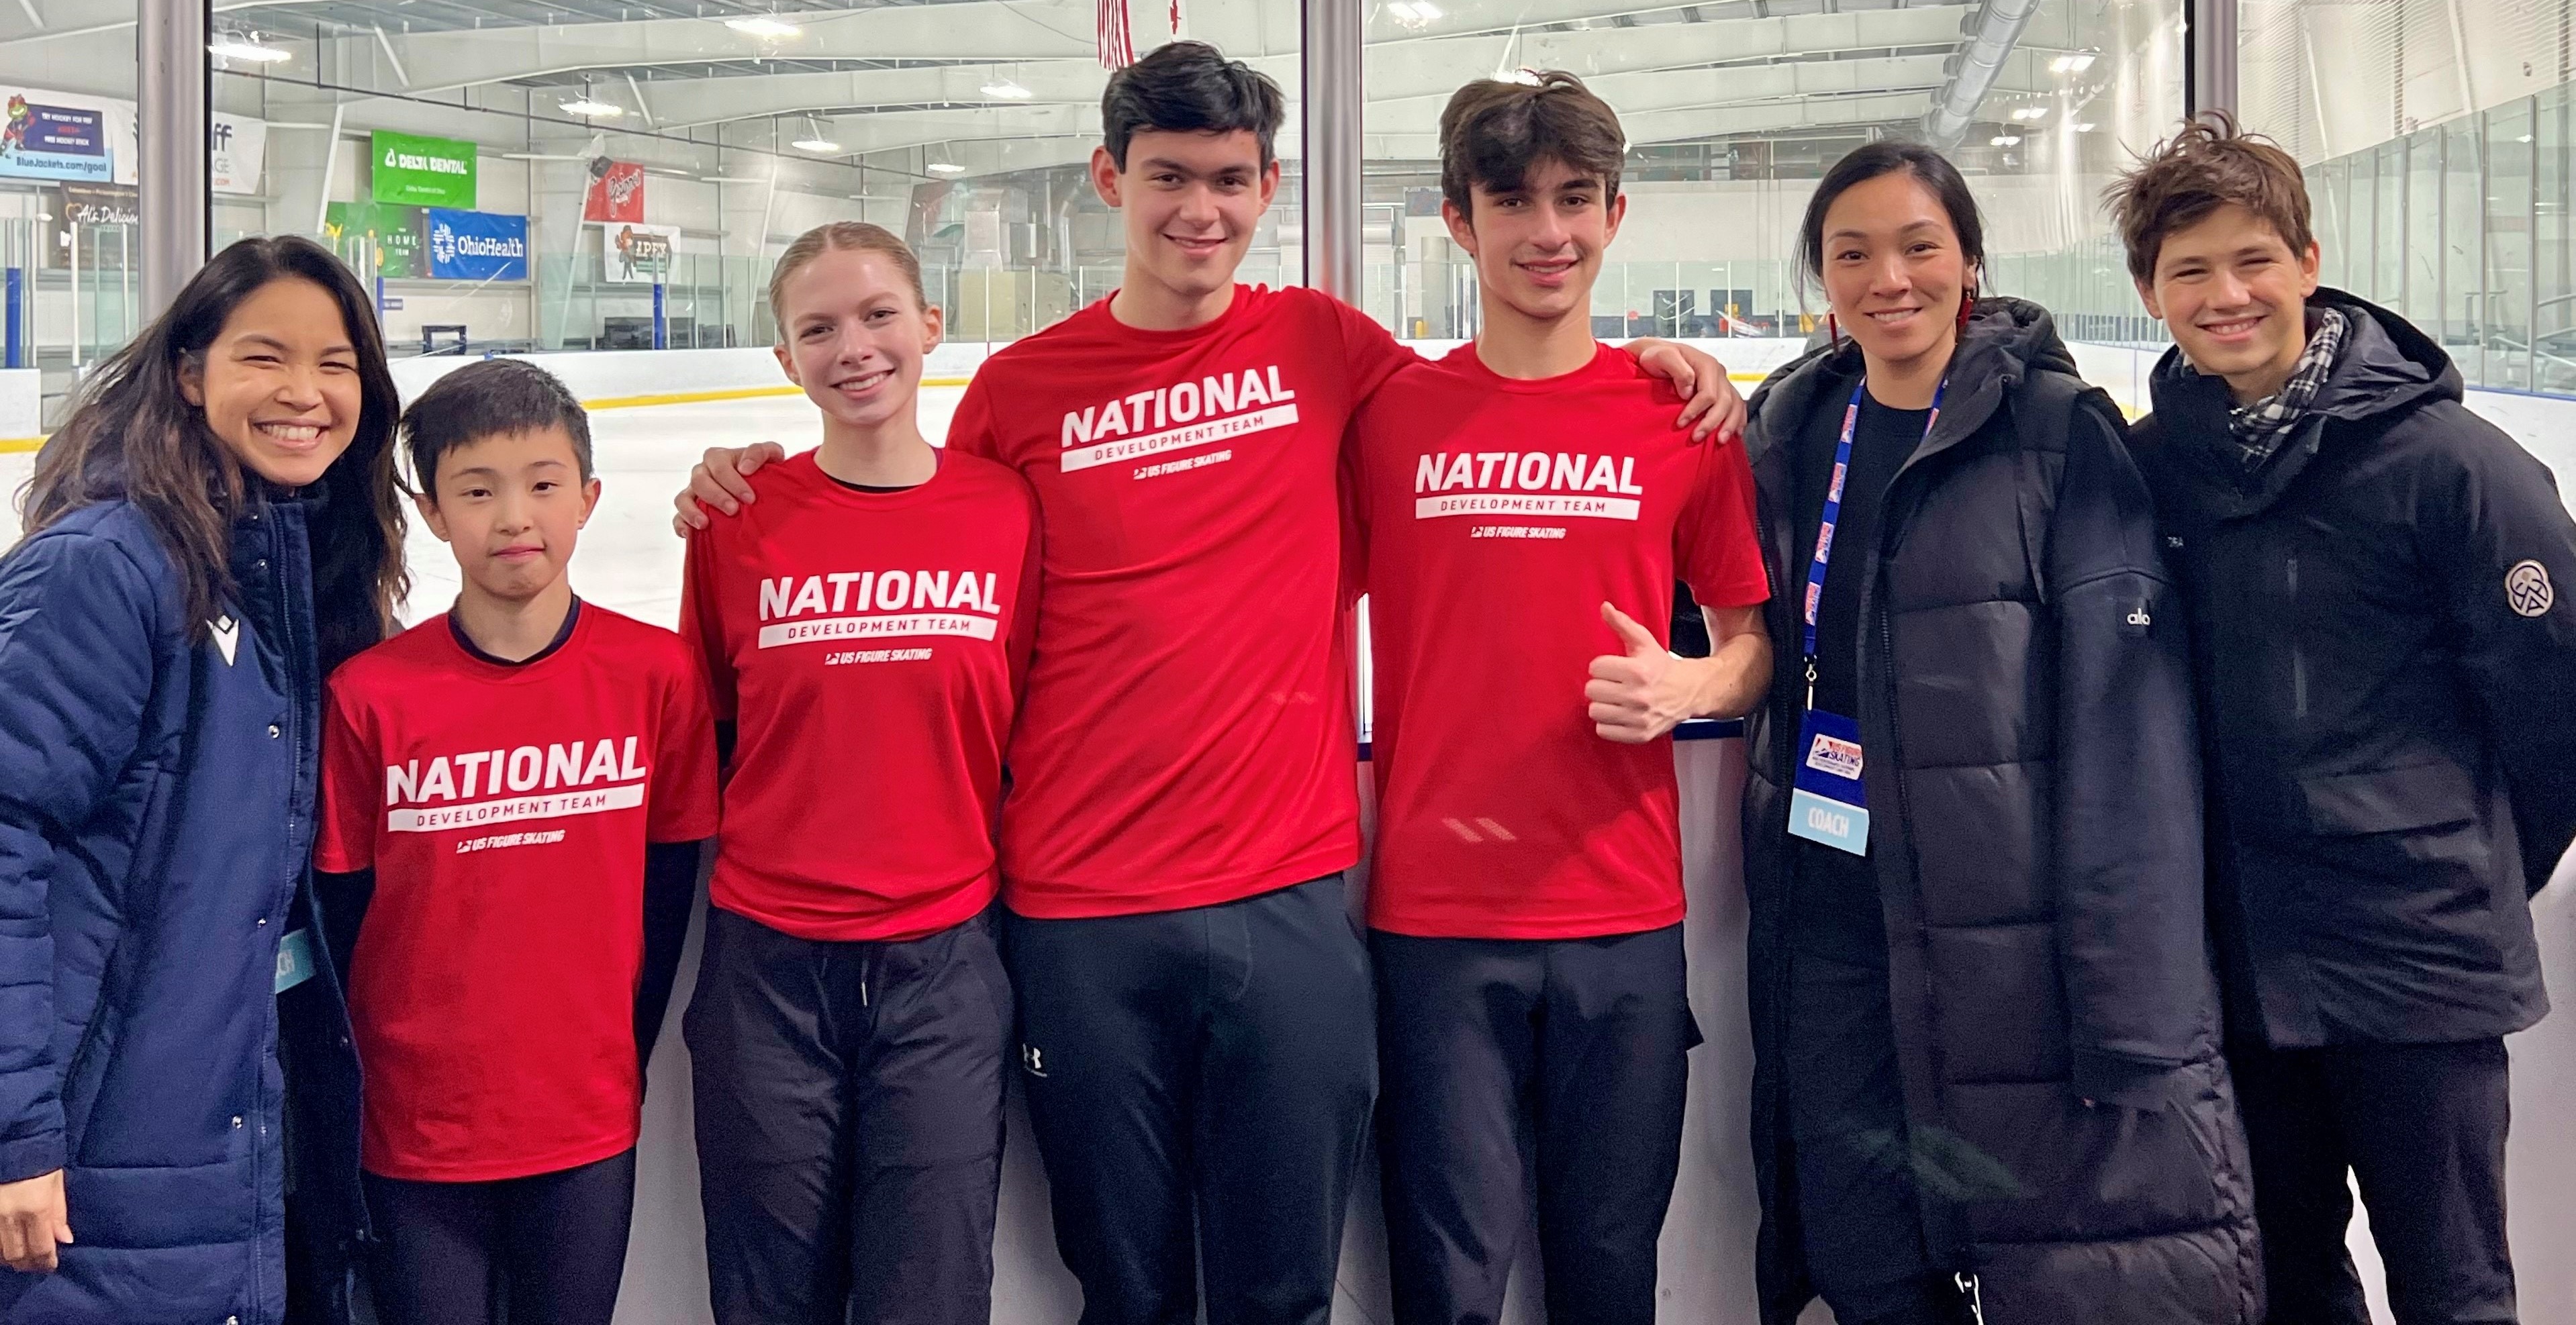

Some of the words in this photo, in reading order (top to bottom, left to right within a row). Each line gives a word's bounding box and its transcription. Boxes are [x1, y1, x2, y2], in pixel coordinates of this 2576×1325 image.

[16, 156, 107, 174] BlueJackets.com/goal
[399, 154, 428, 170] DELTA
[430, 156, 467, 175] DENTAL
[387, 235, 416, 246] HOME
[458, 236, 524, 257] OhioHealth
[1061, 366, 1295, 448] NATIONAL
[1094, 427, 1213, 460] DEVELOPMENT
[1223, 415, 1264, 434] TEAM
[1147, 464, 1161, 477] US
[1161, 458, 1194, 475] FIGURE
[1193, 450, 1232, 468] SKATING
[1415, 452, 1643, 495] NATIONAL
[1441, 499, 1556, 511] DEVELOPMENT
[1564, 501, 1606, 512] TEAM
[1483, 526, 1496, 538] US
[1496, 526, 1529, 538] FIGURE
[1527, 527, 1566, 538] SKATING
[759, 570, 1001, 621] NATIONAL
[2127, 607, 2150, 626] alo
[788, 619, 920, 639] DEVELOPMENT
[928, 619, 970, 631] TEAM
[840, 652, 855, 665] US
[855, 650, 891, 663] FIGURE
[890, 648, 933, 661] SKATING
[387, 736, 647, 806] NATIONAL
[417, 801, 551, 826] DEVELOPMENT
[561, 794, 606, 811] TEAM
[1808, 807, 1850, 838] COACH
[472, 838, 487, 850] US
[487, 833, 524, 848] FIGURE
[522, 830, 565, 845] SKATING
